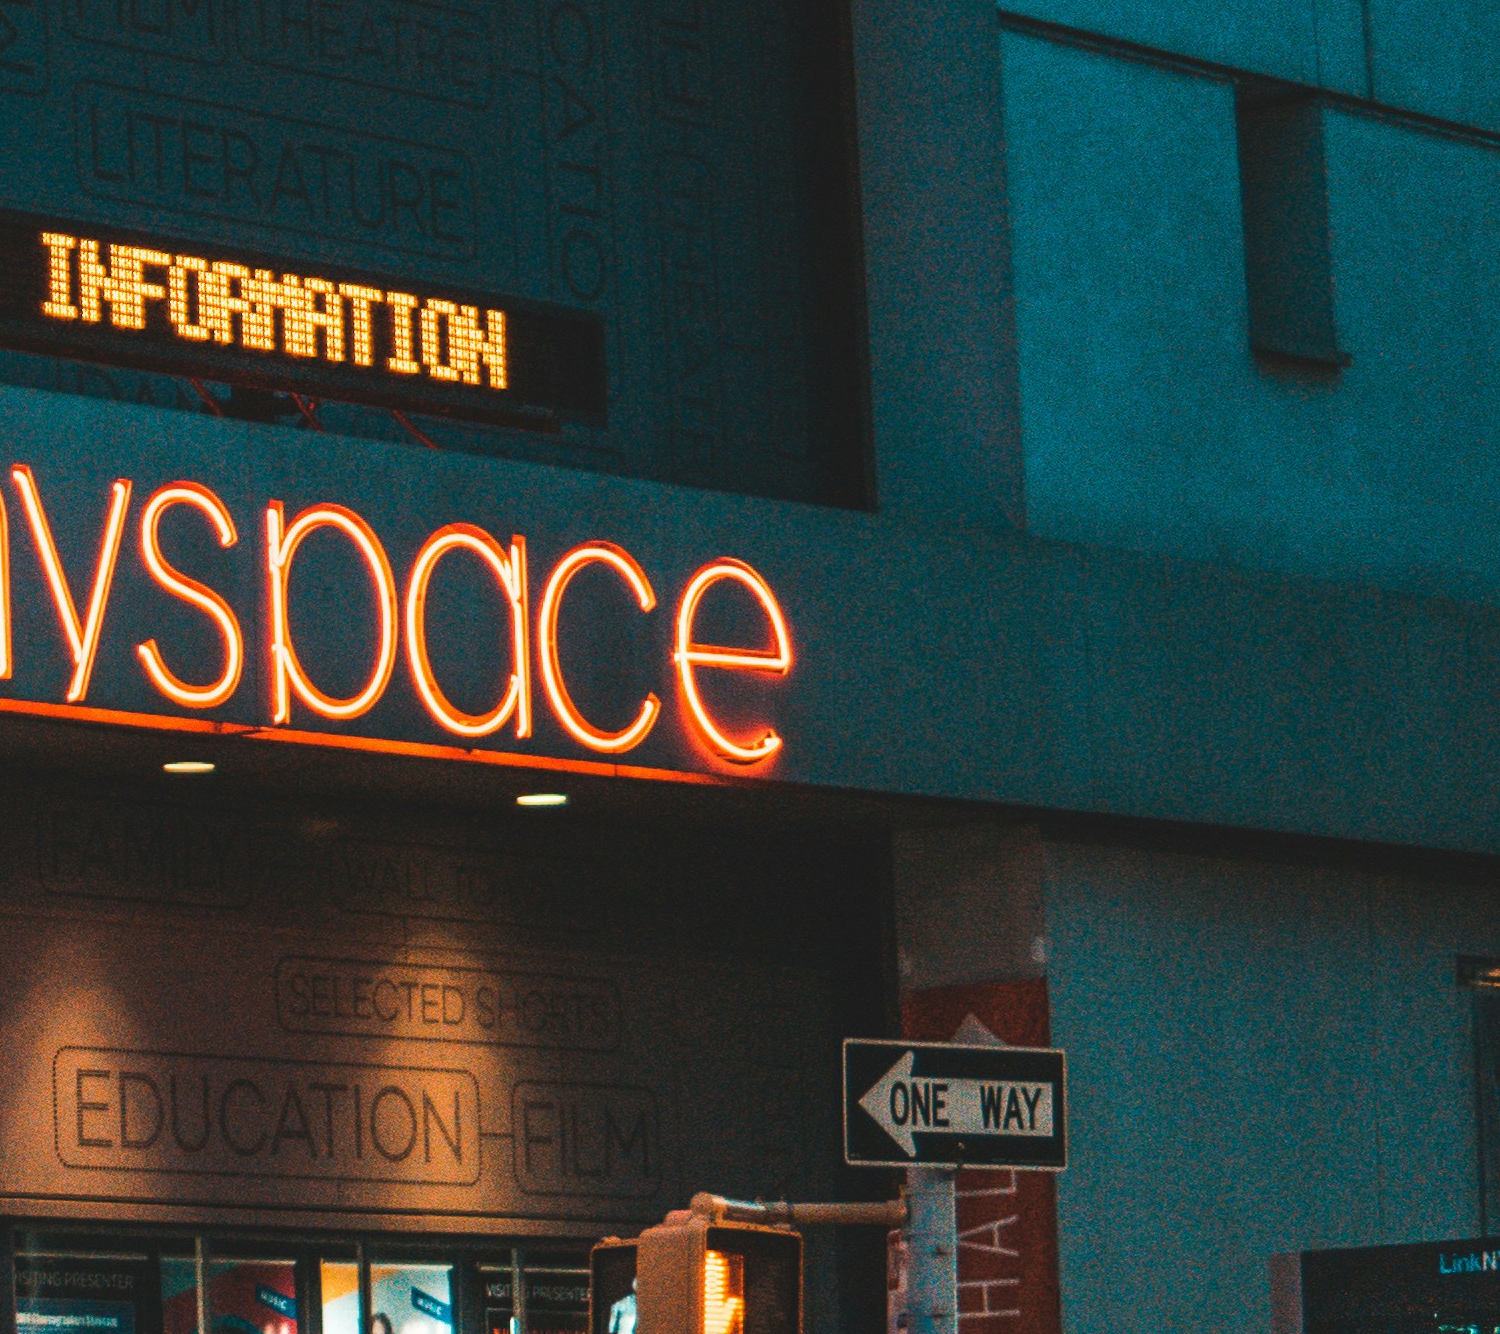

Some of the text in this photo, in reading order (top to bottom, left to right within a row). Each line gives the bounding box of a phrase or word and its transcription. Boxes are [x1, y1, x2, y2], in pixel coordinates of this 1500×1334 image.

[38, 228, 509, 391] INFORMATION
[290, 969, 468, 1029] SELECTED
[74, 1068, 467, 1163] EDUCATION
[889, 1078, 1044, 1133] ONE WAY
[522, 1101, 654, 1179] FILM
[485, 1282, 531, 1300] VISITG
[1438, 1250, 1500, 1274] LinkN
